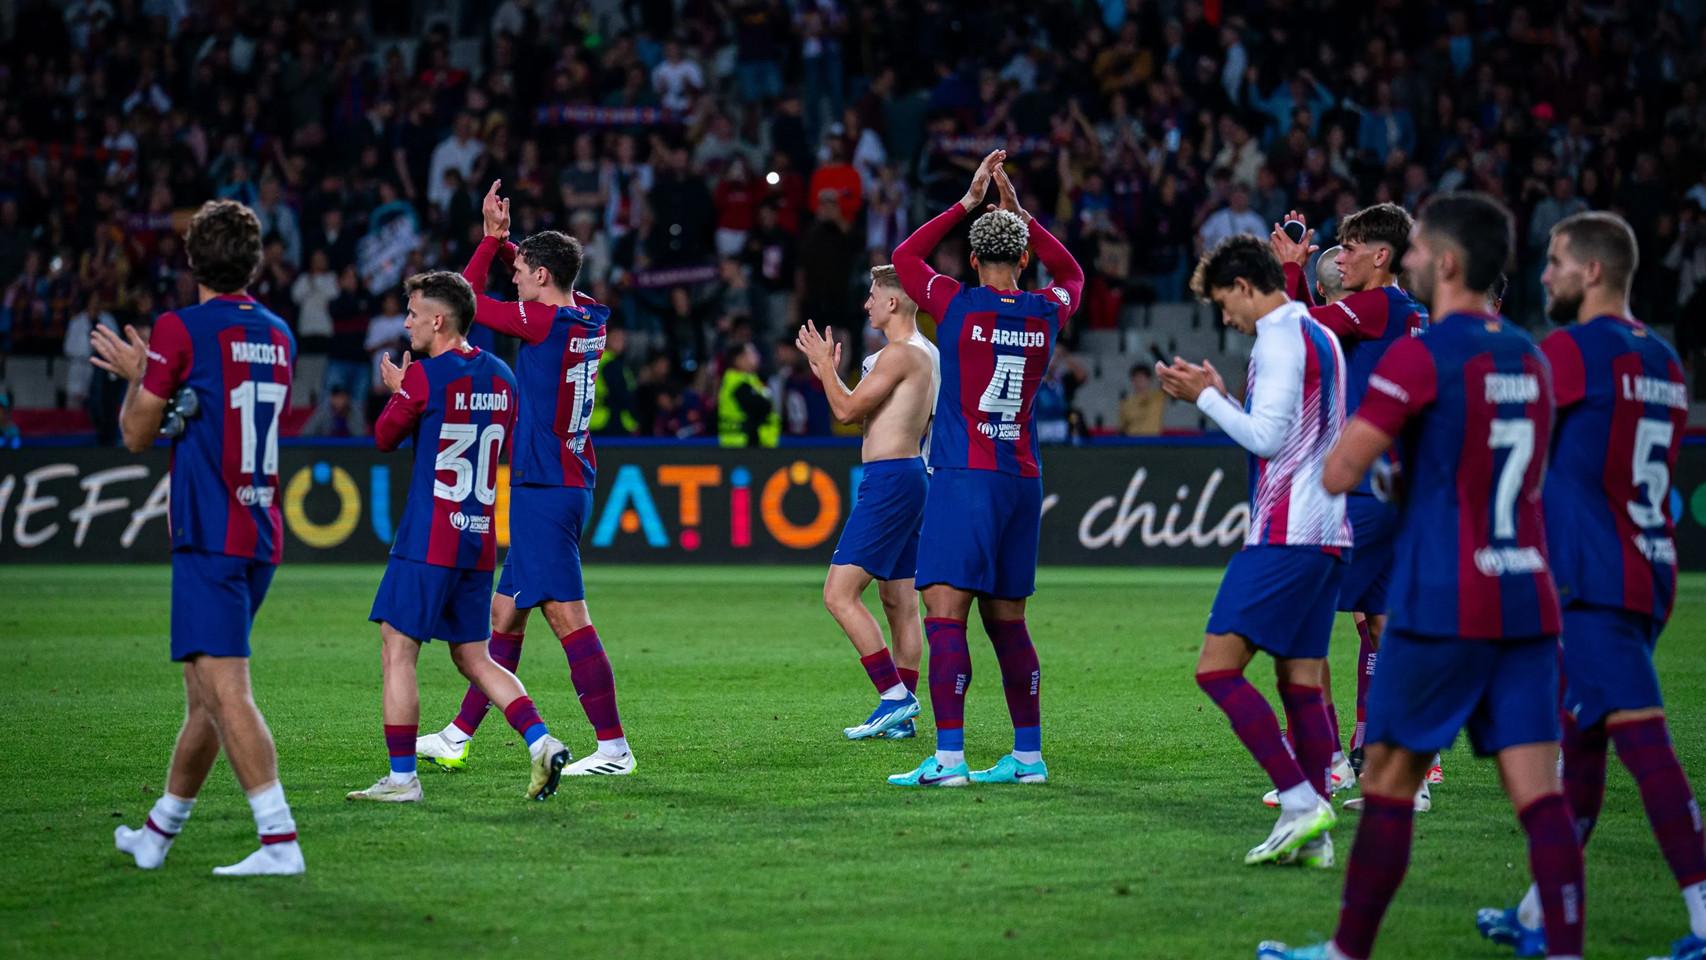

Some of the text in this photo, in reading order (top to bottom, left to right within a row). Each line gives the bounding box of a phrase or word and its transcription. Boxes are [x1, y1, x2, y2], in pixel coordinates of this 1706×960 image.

[231, 341, 276, 364] MARCOS
[971, 325, 1045, 348] R. ARAUJO
[455, 389, 508, 412] M. CASADÓ
[566, 359, 600, 433] 15
[978, 355, 1027, 421] 4
[230, 380, 288, 475] 17
[433, 423, 506, 506] 30
[1487, 418, 1535, 539] 7
[1626, 417, 1675, 528] 5
